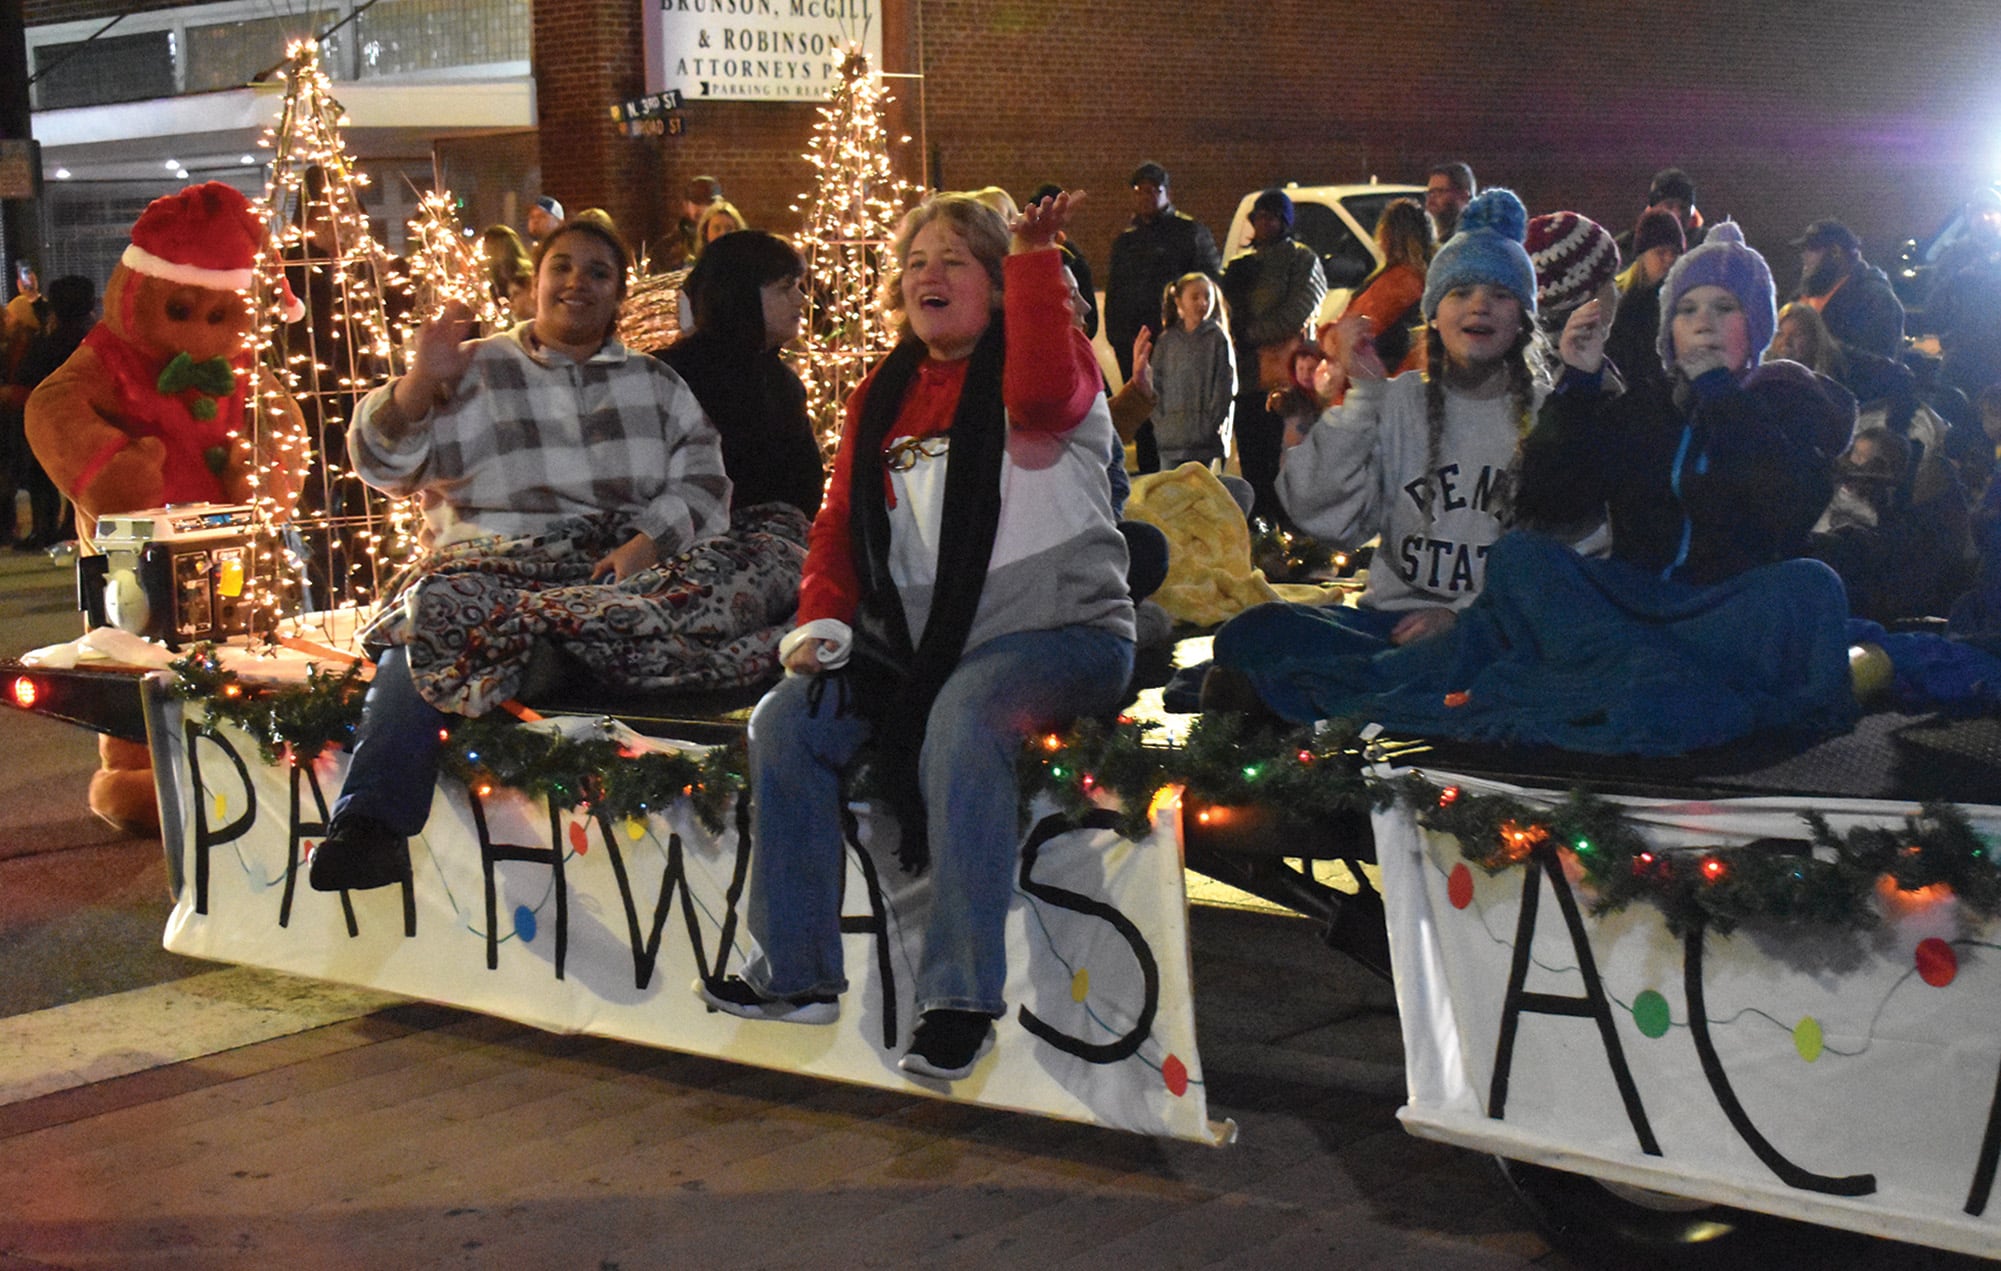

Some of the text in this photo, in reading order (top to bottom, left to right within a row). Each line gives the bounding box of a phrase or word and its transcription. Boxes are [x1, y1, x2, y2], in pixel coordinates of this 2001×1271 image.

[698, 28, 710, 48] &
[676, 58, 811, 79] ATTORNEYS
[711, 84, 771, 96] PARKING
[776, 85, 790, 96] IN
[662, 92, 677, 109] ST
[1404, 463, 1513, 523] PEN
